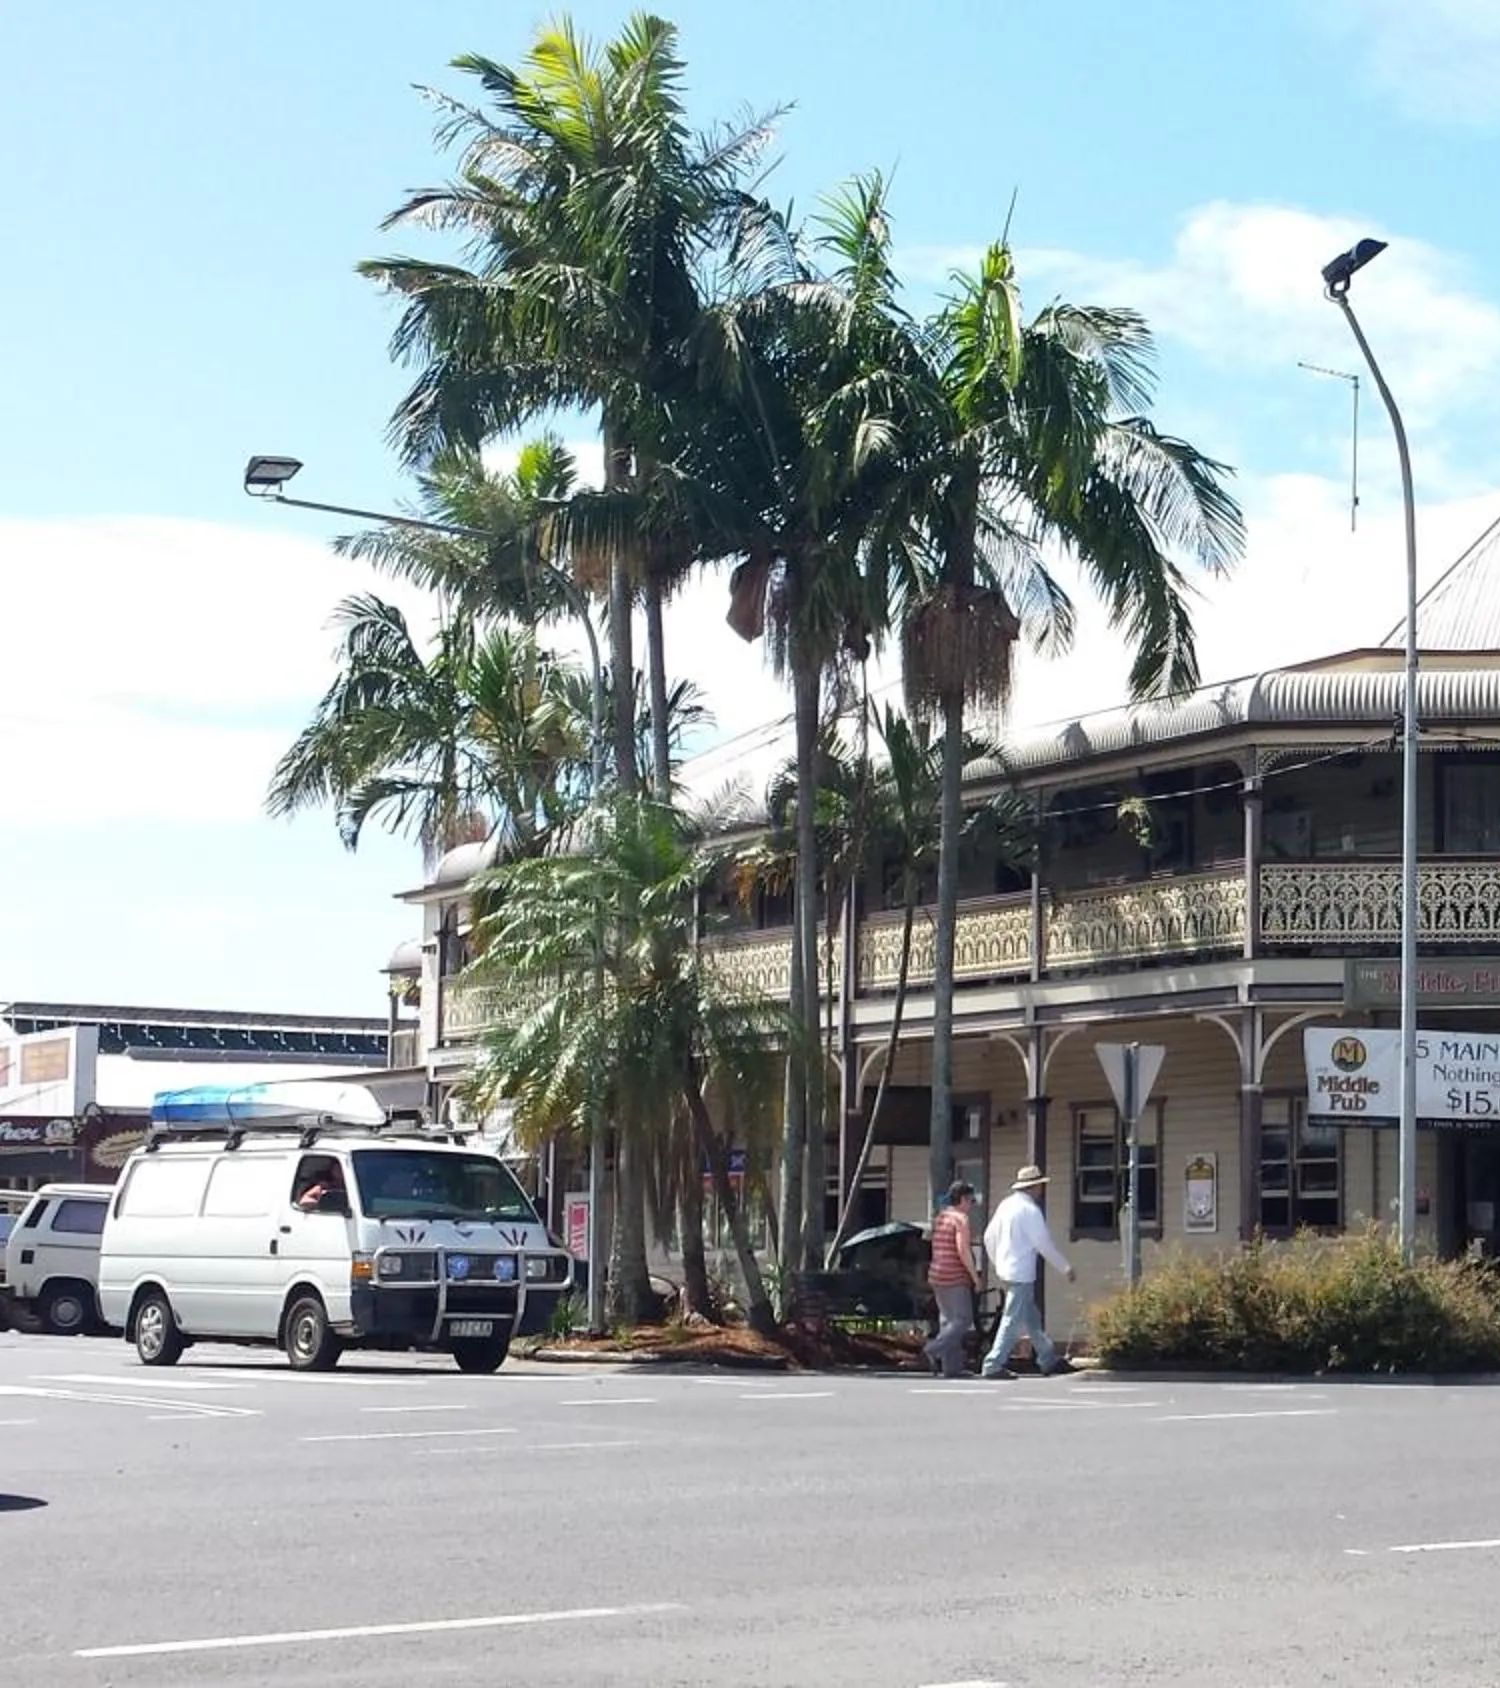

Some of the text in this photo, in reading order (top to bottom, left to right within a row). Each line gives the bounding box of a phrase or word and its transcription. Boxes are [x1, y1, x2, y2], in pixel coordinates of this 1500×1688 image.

[1439, 1041, 1499, 1062] MAIN
[1316, 1075, 1380, 1095] Middle
[1329, 1094, 1368, 1111] Pub
